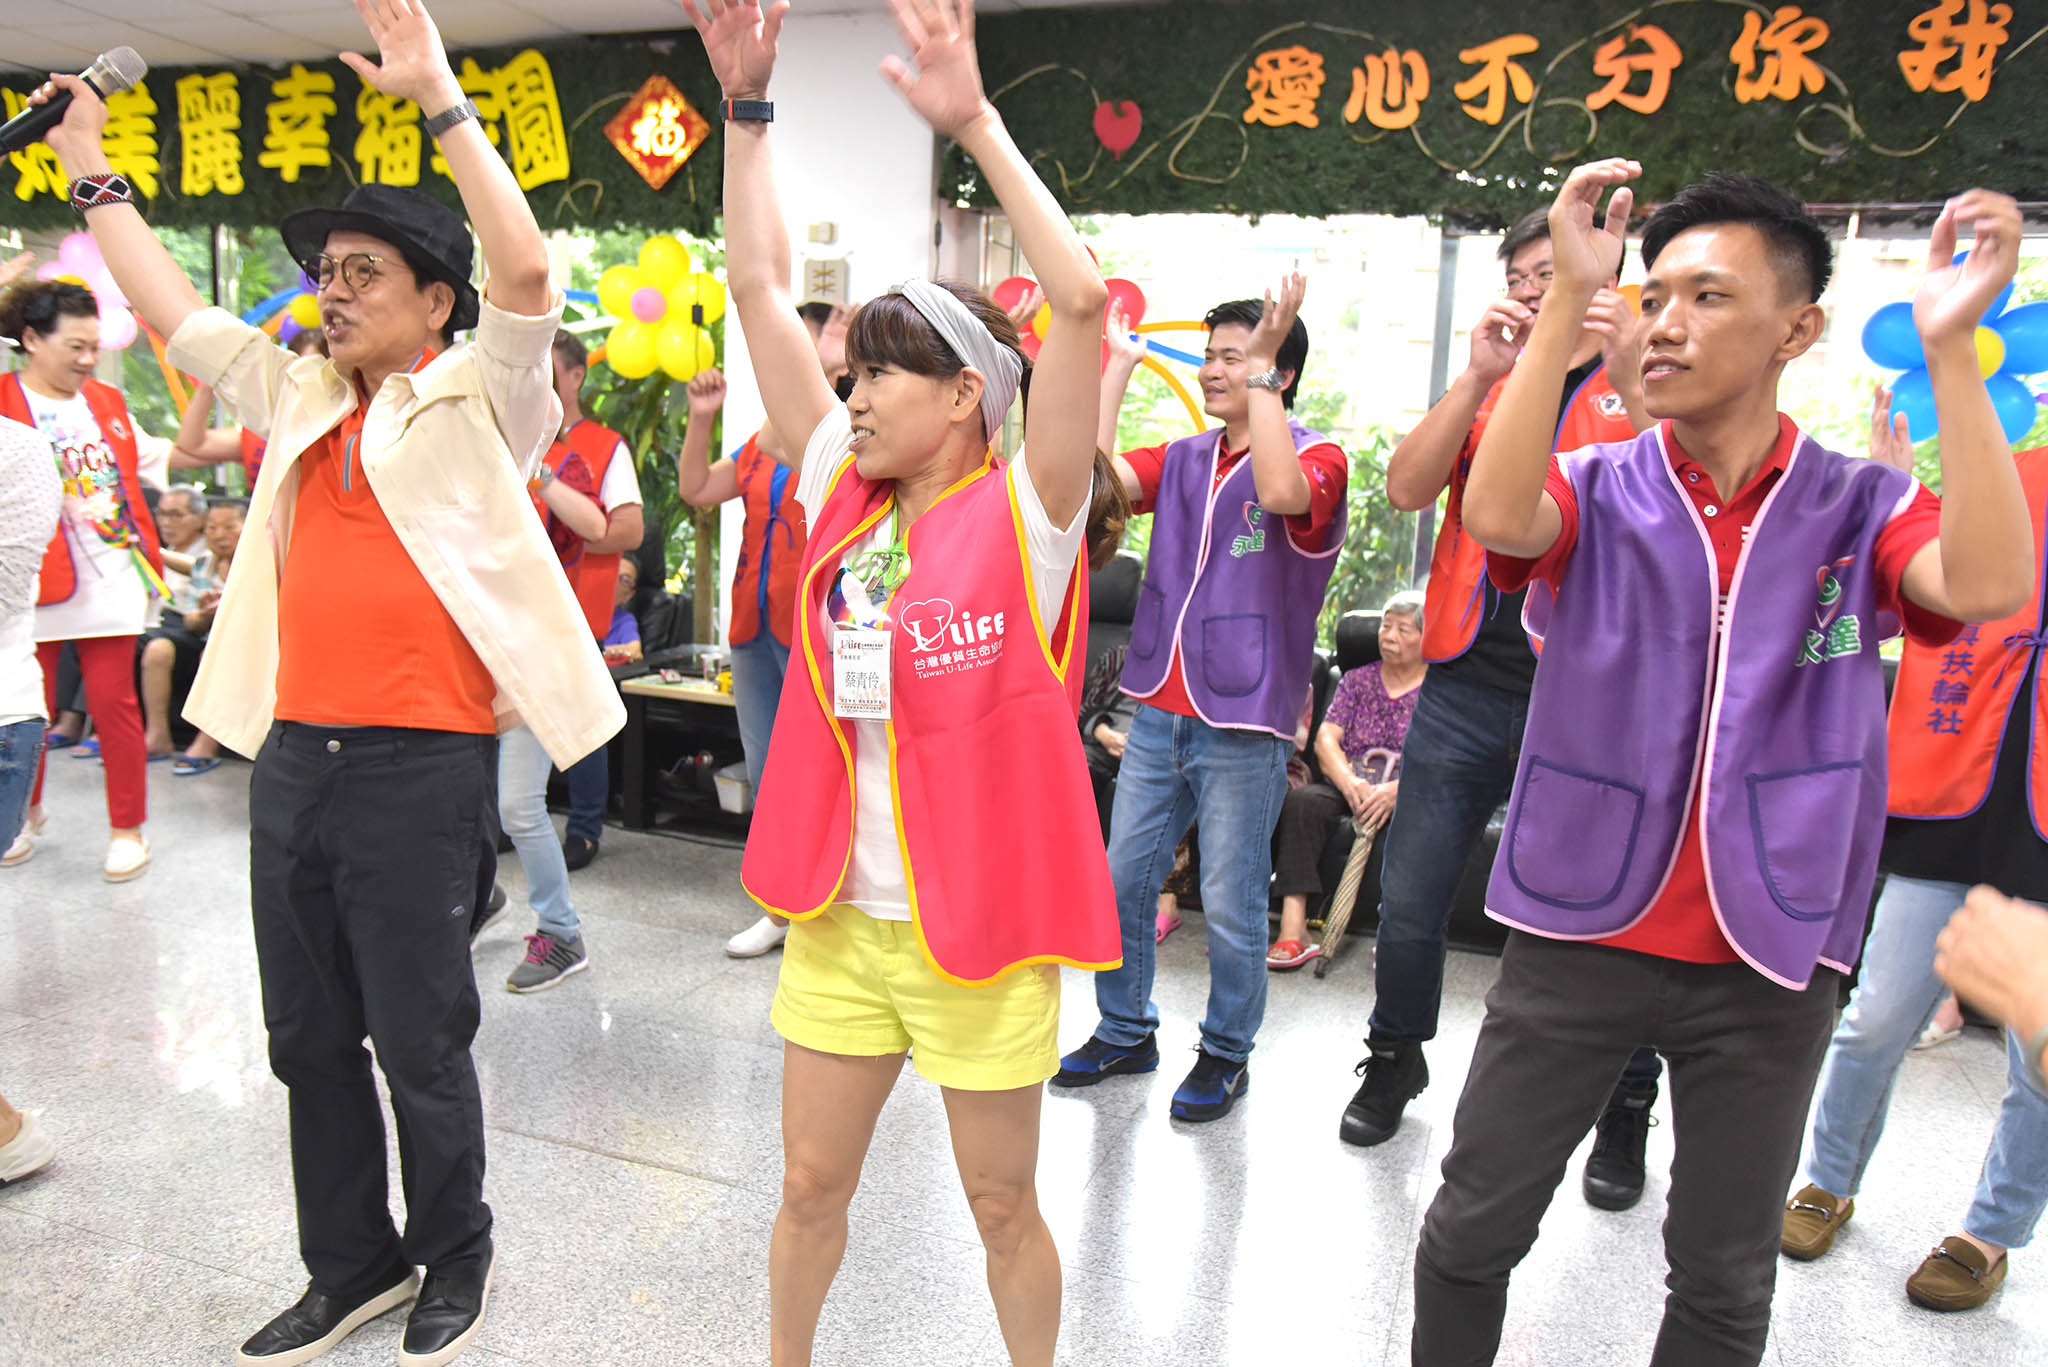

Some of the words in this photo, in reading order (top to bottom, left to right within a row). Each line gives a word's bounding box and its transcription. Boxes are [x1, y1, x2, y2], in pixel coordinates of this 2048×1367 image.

[1243, 0, 2012, 129] 愛心不分你我
[631, 99, 687, 157] 福
[916, 669, 945, 679] Taiwan
